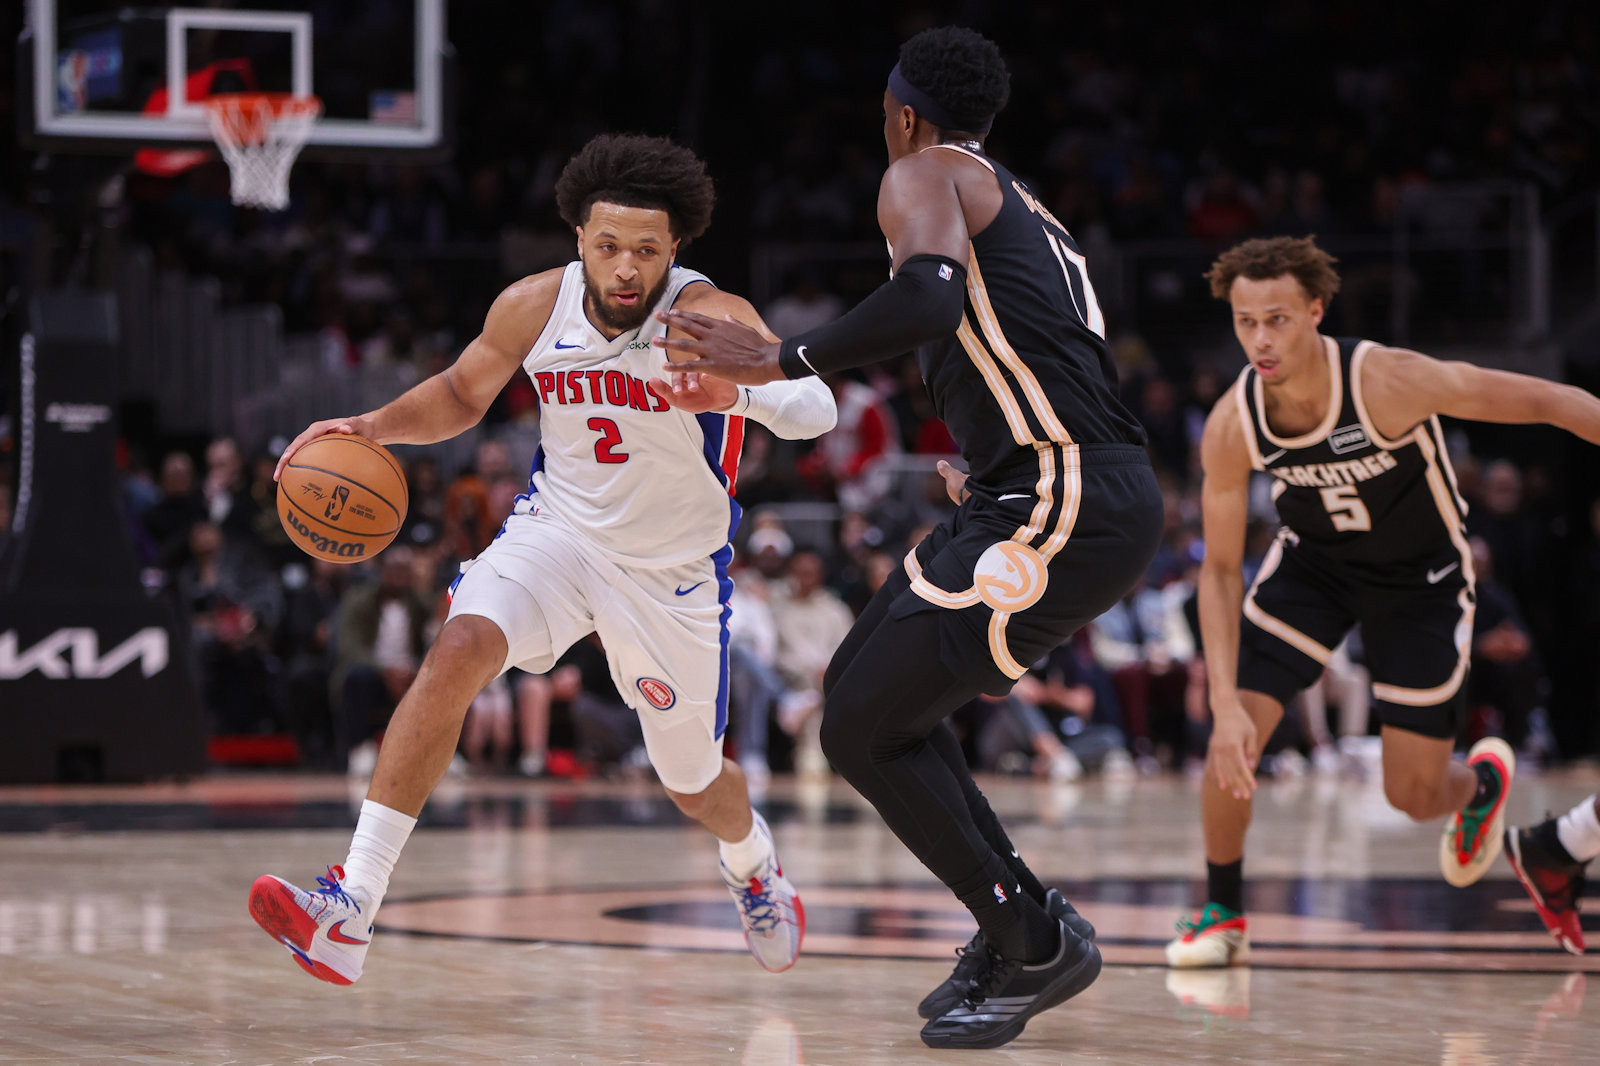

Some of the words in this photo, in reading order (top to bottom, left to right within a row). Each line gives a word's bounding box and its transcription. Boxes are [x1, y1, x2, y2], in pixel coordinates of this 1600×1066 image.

[1042, 225, 1105, 341] 17
[626, 341, 650, 350] ckX
[534, 370, 671, 412] PISTONS
[587, 417, 629, 464] 2
[1271, 451, 1398, 487] EACHTREE
[1318, 485, 1371, 532] 5
[287, 509, 365, 557] Wilson
